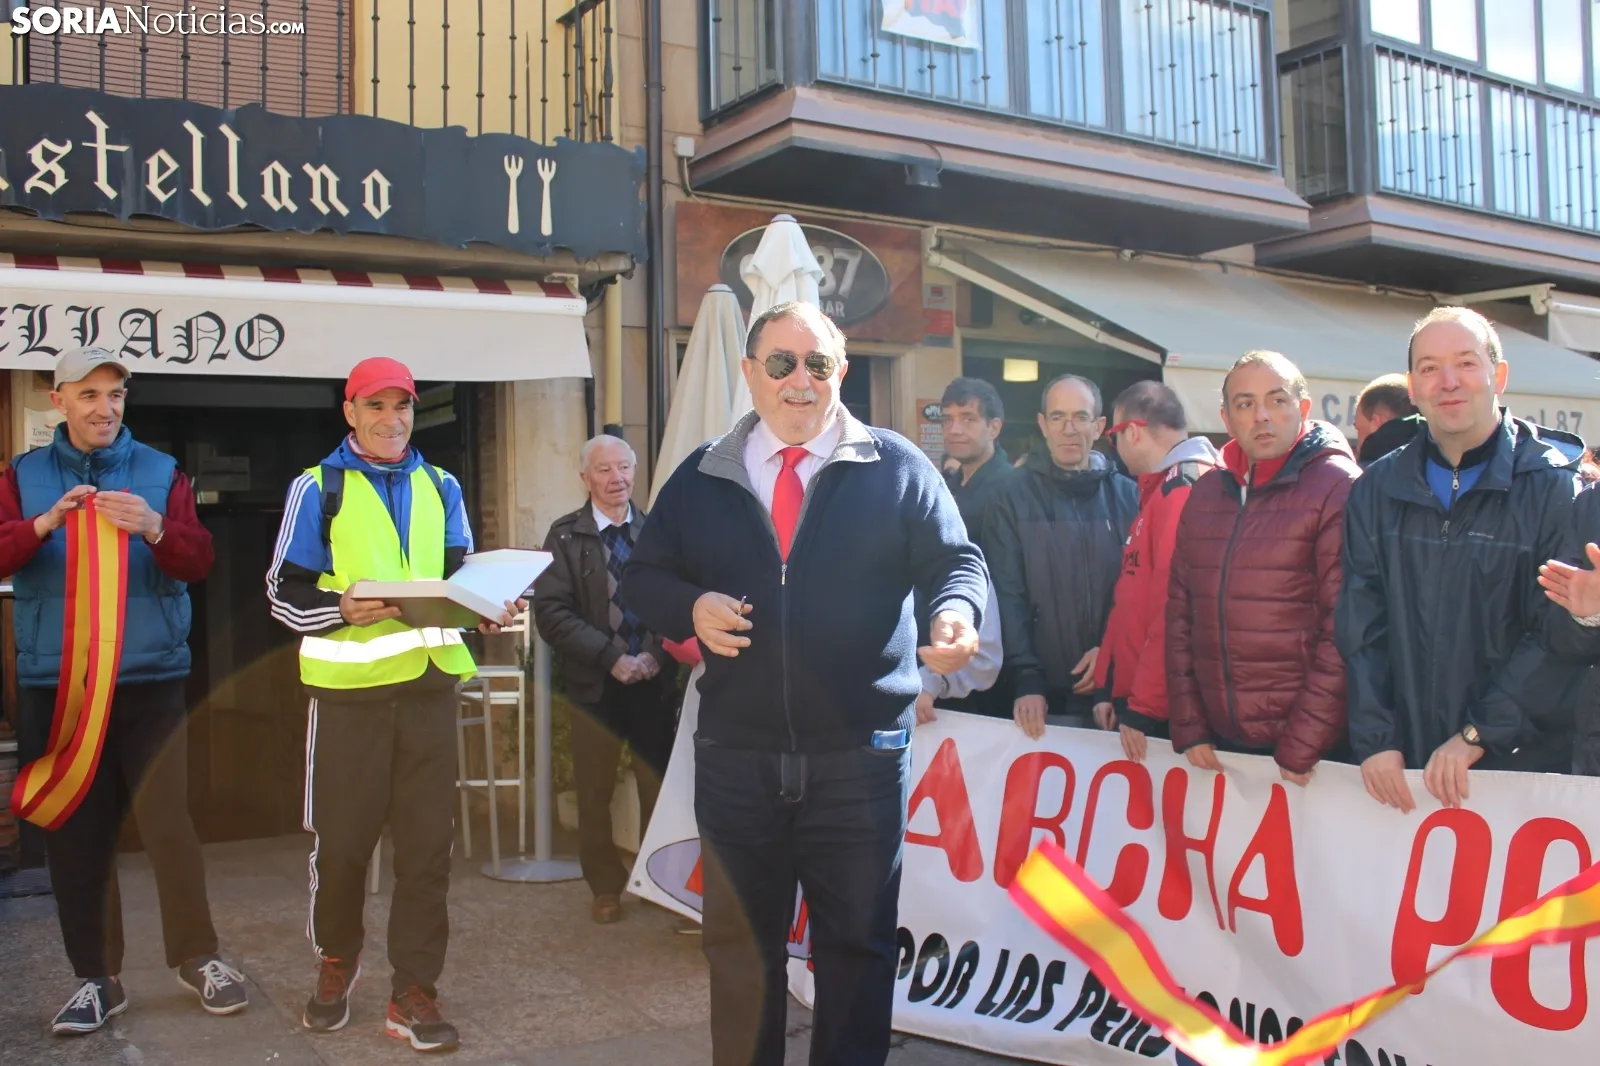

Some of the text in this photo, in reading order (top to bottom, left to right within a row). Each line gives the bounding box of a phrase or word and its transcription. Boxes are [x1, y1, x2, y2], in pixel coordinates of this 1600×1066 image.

[0, 110, 391, 220] stellano
[0, 303, 285, 365] LLANO
[975, 948, 1067, 1024] LAS
